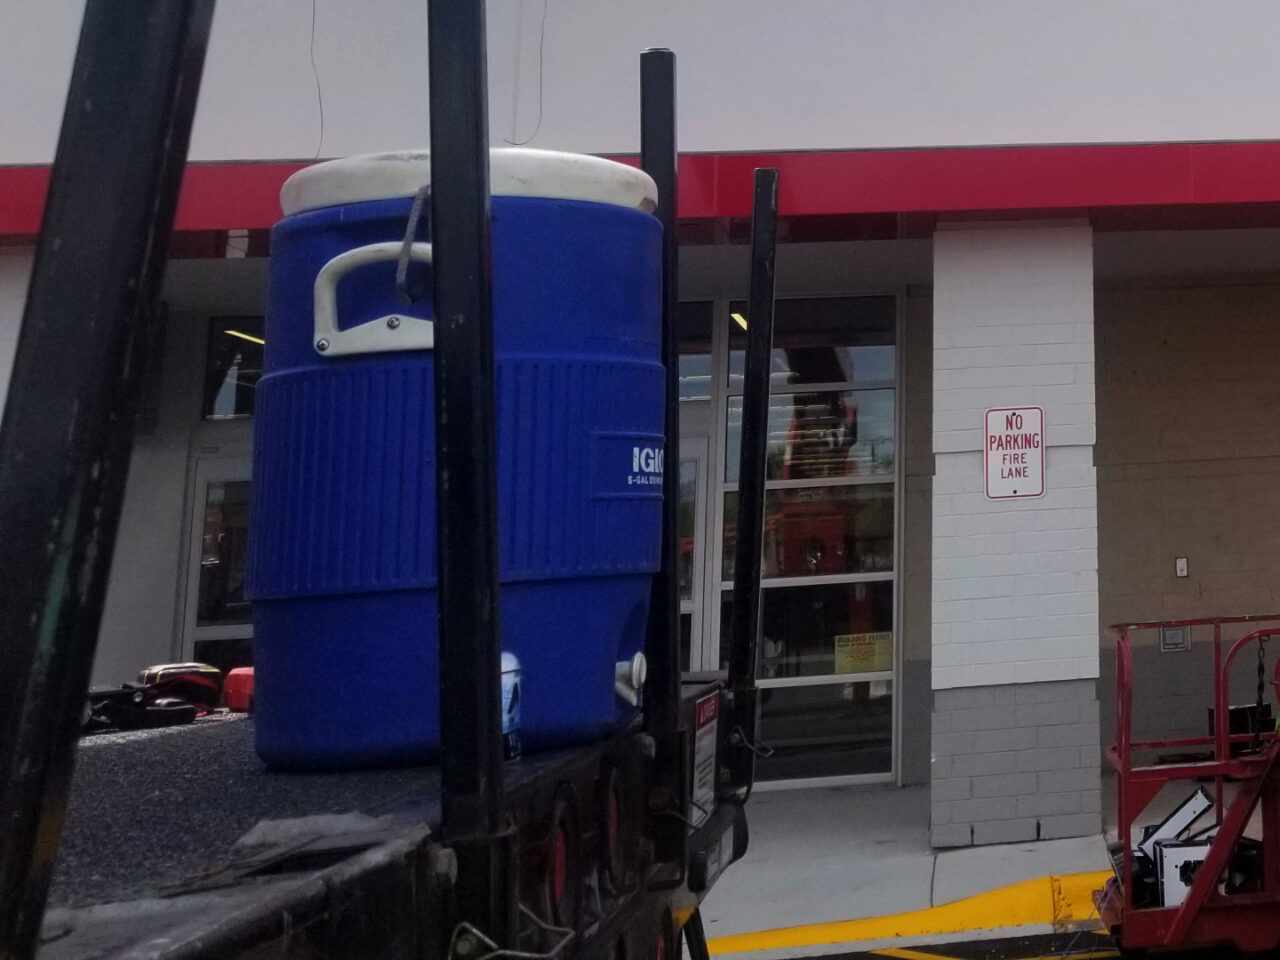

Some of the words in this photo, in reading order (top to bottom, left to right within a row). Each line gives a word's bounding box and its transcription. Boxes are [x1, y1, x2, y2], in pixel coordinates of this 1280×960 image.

[1005, 414, 1023, 431] NO
[989, 433, 1040, 451] PARKING
[1003, 452, 1028, 465] FIRE
[1001, 466, 1029, 479] LANE
